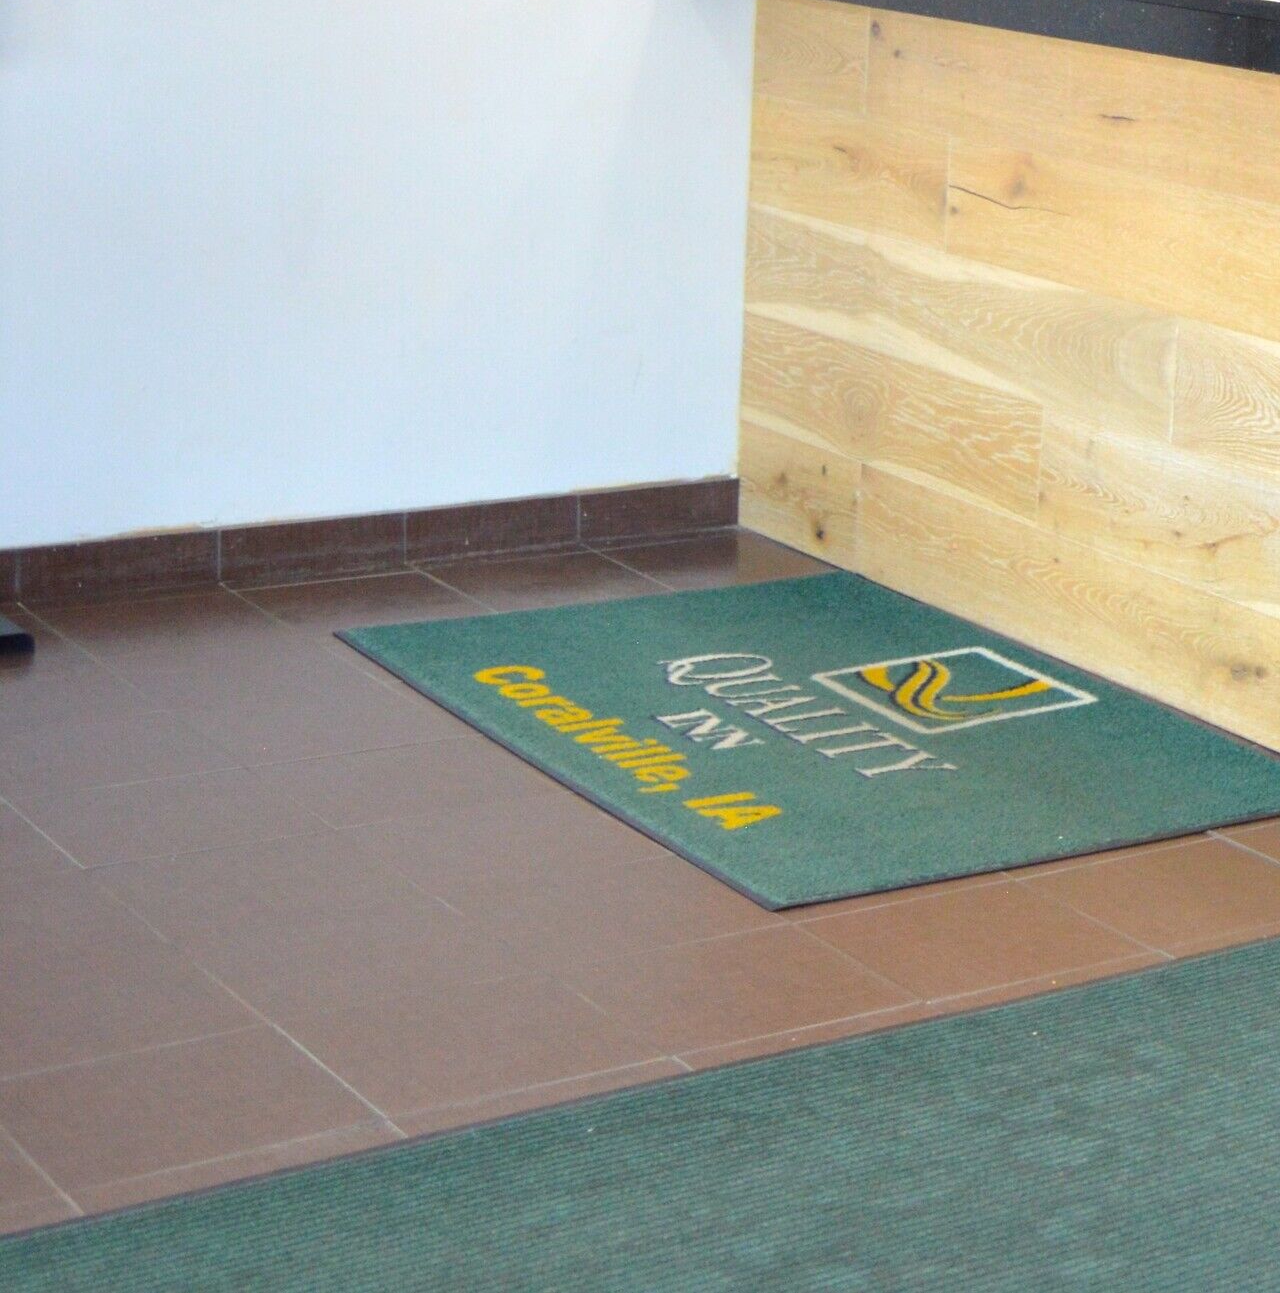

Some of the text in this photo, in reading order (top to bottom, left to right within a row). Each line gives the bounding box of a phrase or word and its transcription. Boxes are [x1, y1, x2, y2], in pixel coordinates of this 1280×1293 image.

[473, 665, 783, 830] Coralville, IA
[655, 708, 765, 751] INN
[657, 653, 959, 778] QUALITY
